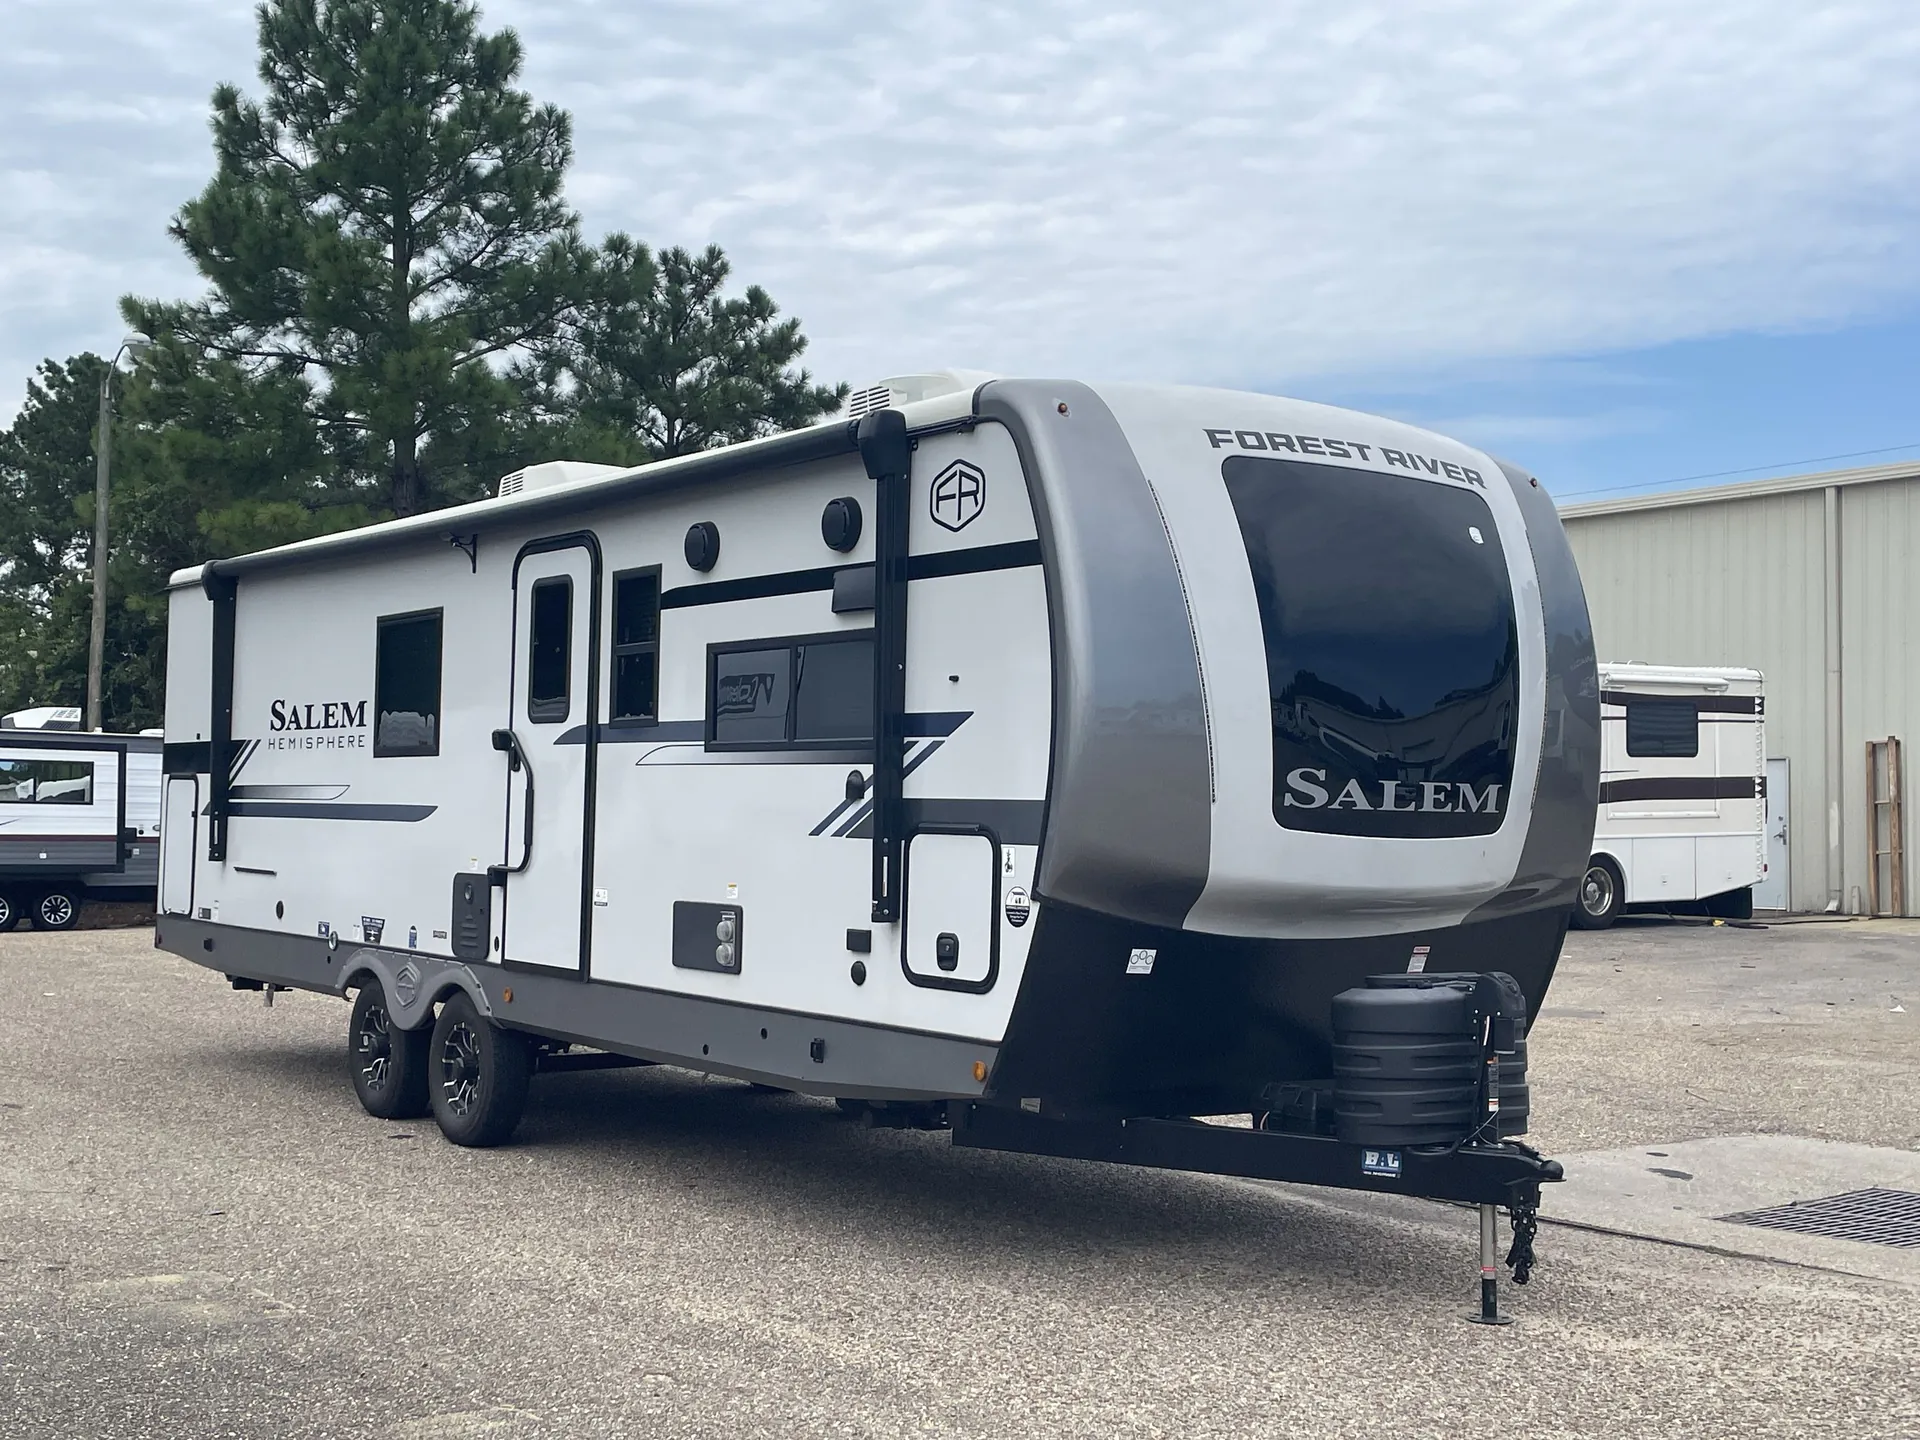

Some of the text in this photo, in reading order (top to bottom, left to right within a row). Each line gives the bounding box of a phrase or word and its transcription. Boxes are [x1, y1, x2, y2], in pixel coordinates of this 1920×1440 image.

[1202, 428, 1487, 490] FOREST RIVER
[268, 735, 365, 750] HEMISPHERE
